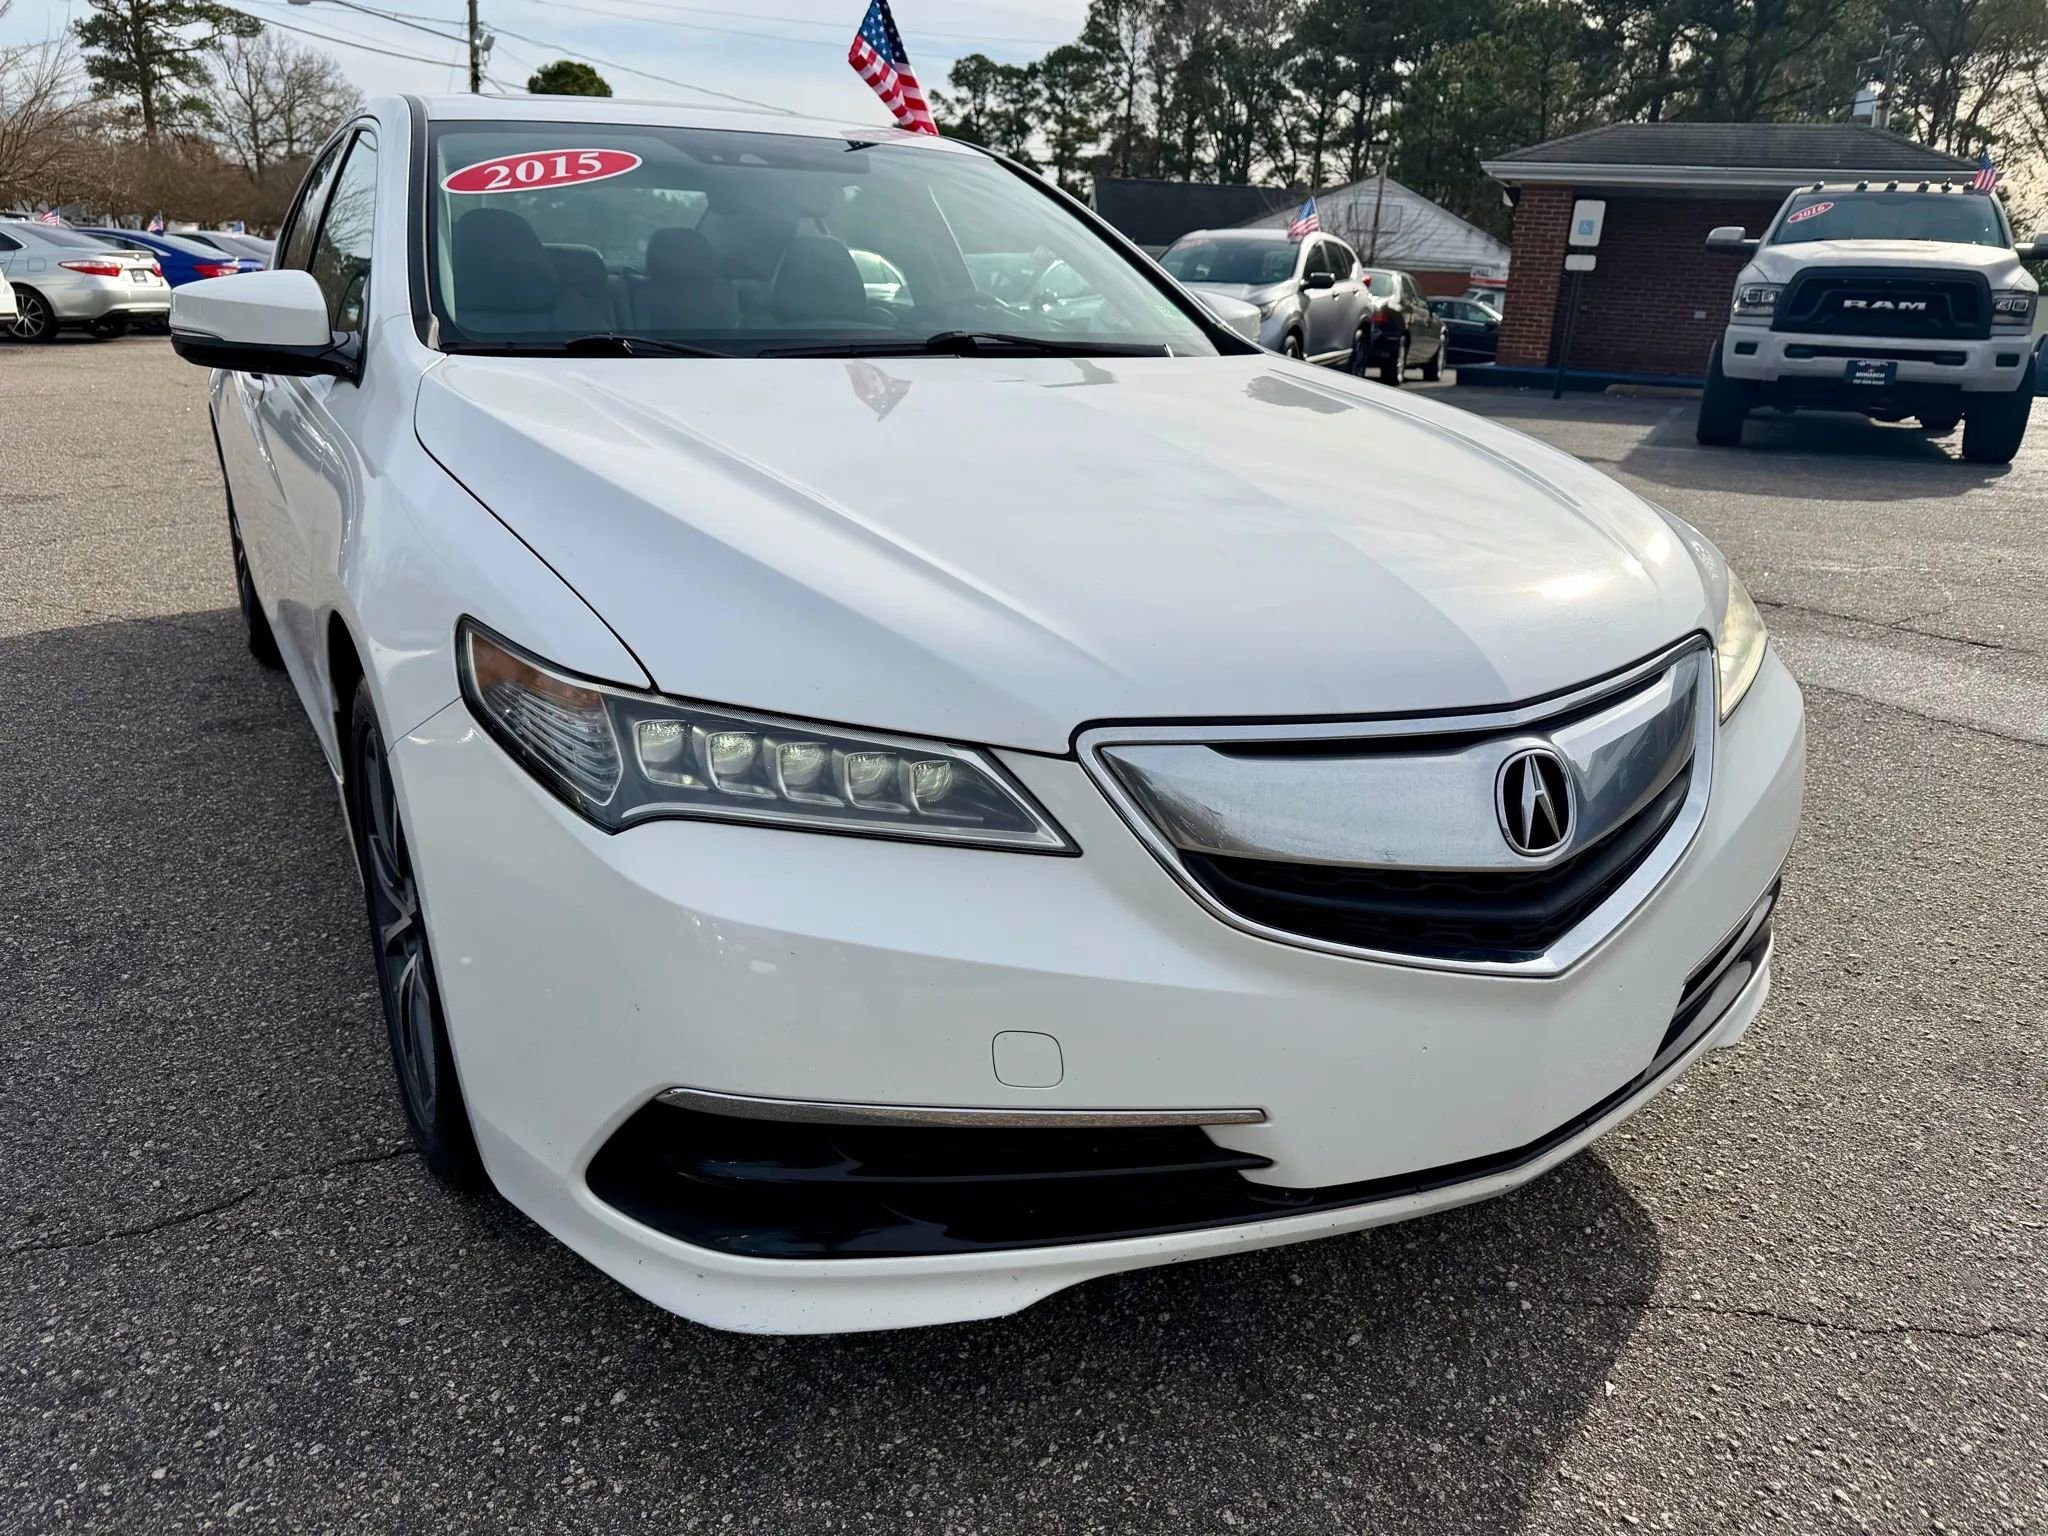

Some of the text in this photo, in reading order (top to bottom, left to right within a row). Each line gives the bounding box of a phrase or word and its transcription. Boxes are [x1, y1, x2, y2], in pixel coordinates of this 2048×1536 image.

[484, 152, 602, 189] 2015
[1799, 204, 1825, 219] 2016
[1843, 299, 1927, 311] RAM
